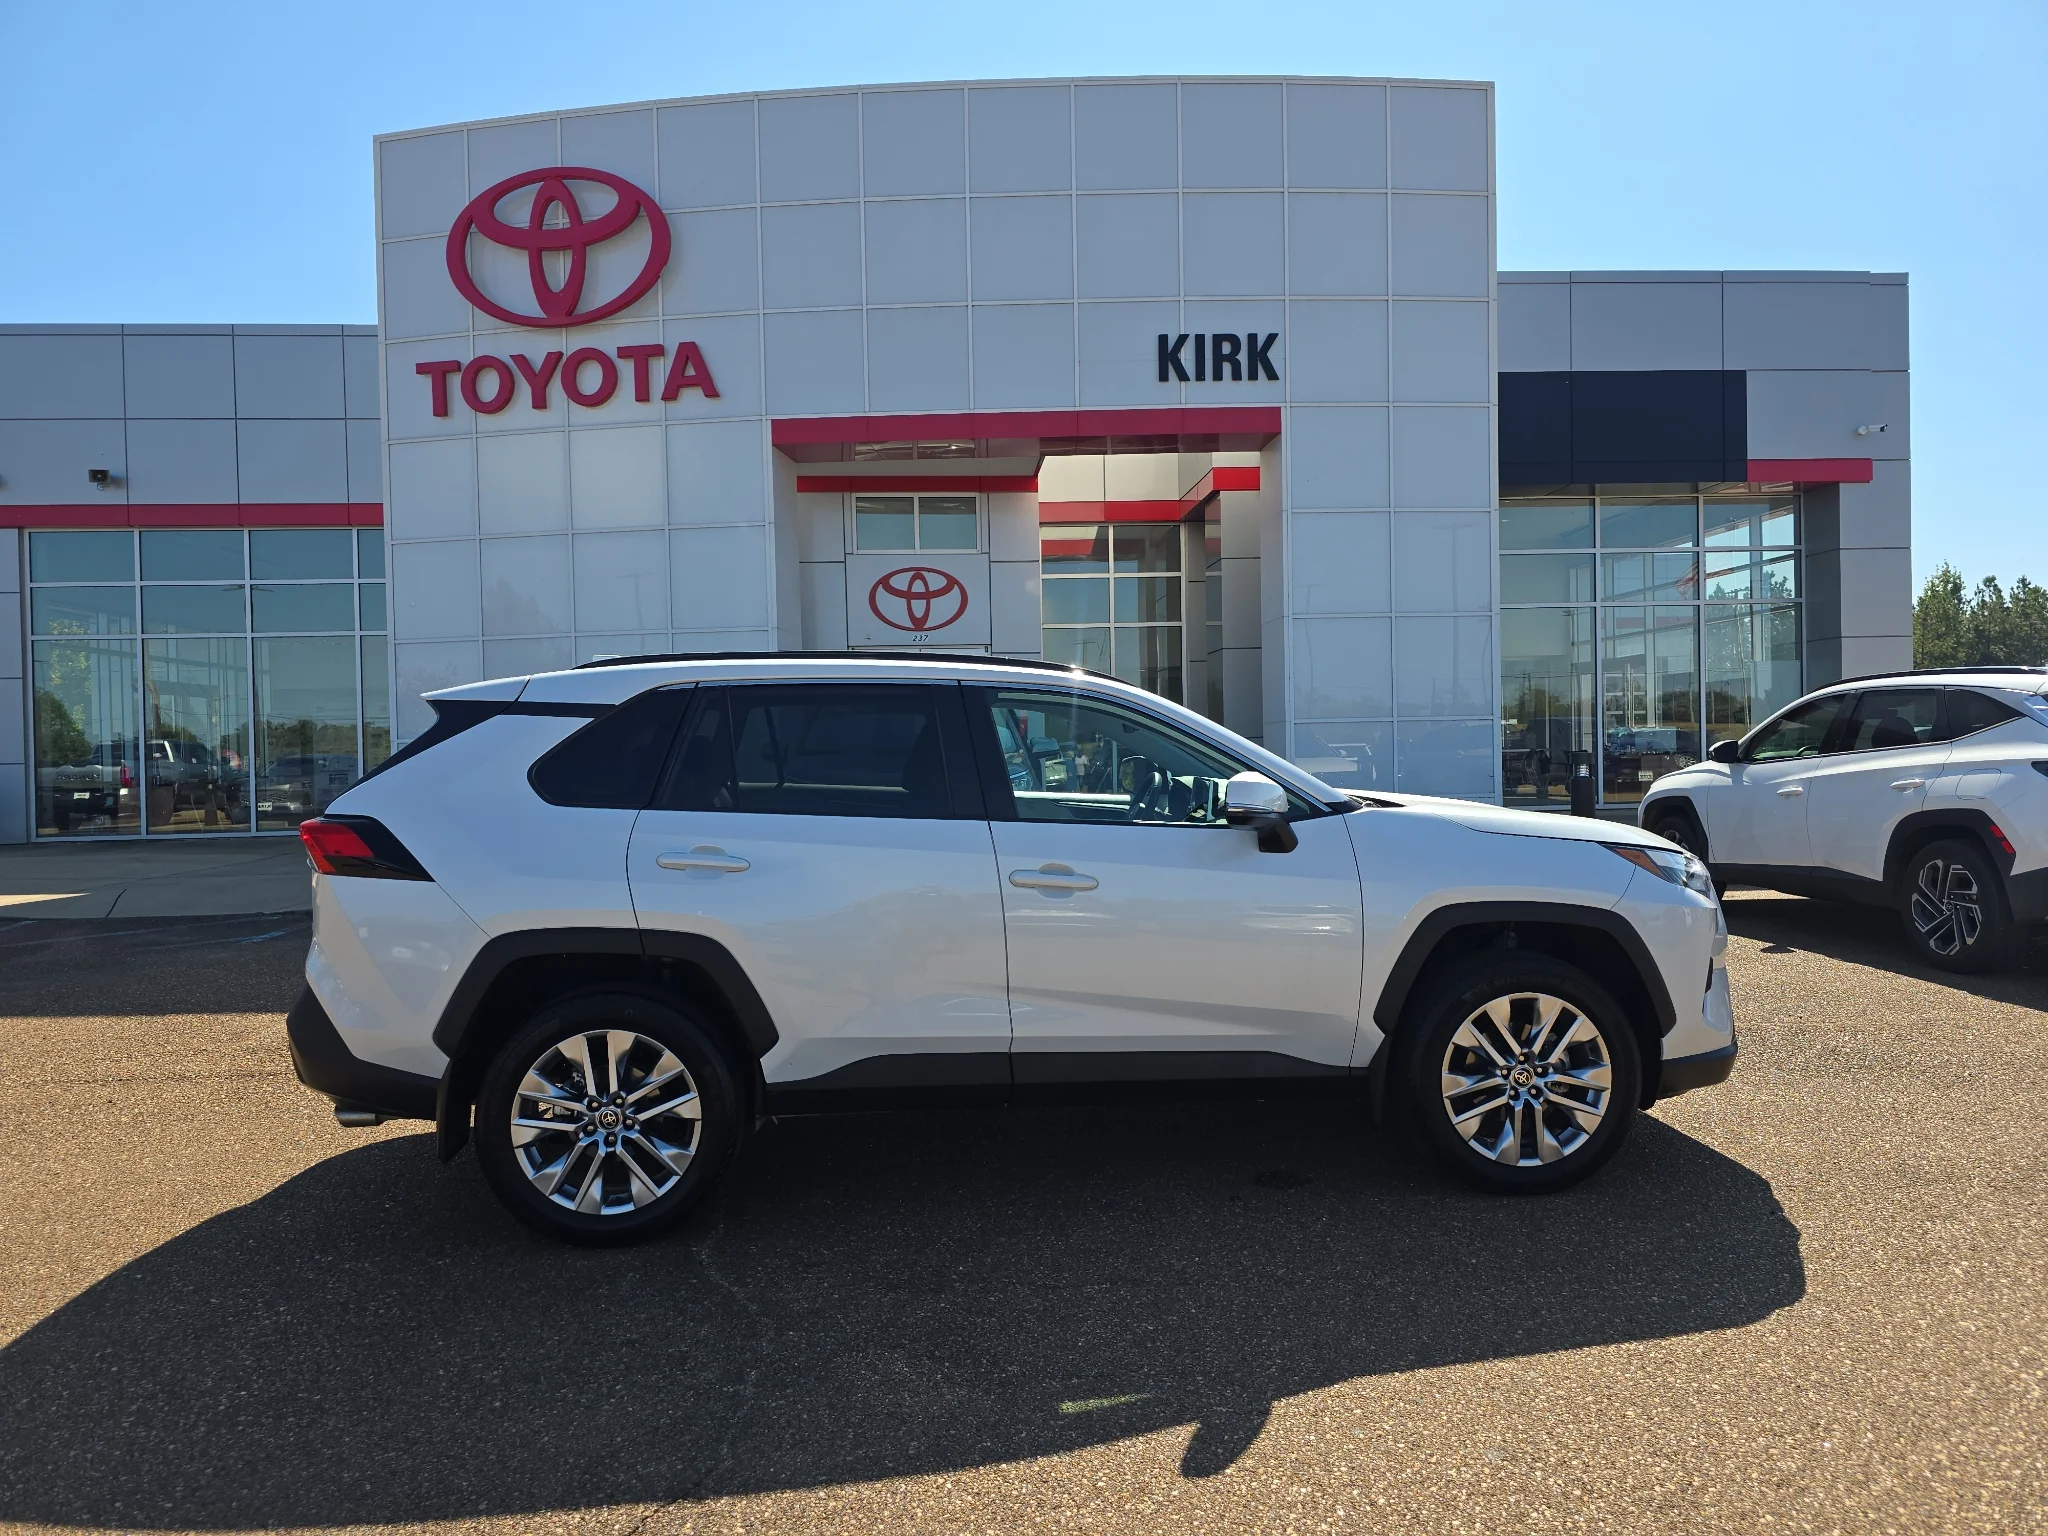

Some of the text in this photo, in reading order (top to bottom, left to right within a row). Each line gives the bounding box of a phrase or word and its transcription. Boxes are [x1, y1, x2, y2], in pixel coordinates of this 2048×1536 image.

[416, 341, 720, 417] TOYOTA
[1158, 333, 1280, 382] KIRK
[912, 634, 929, 642] 237
